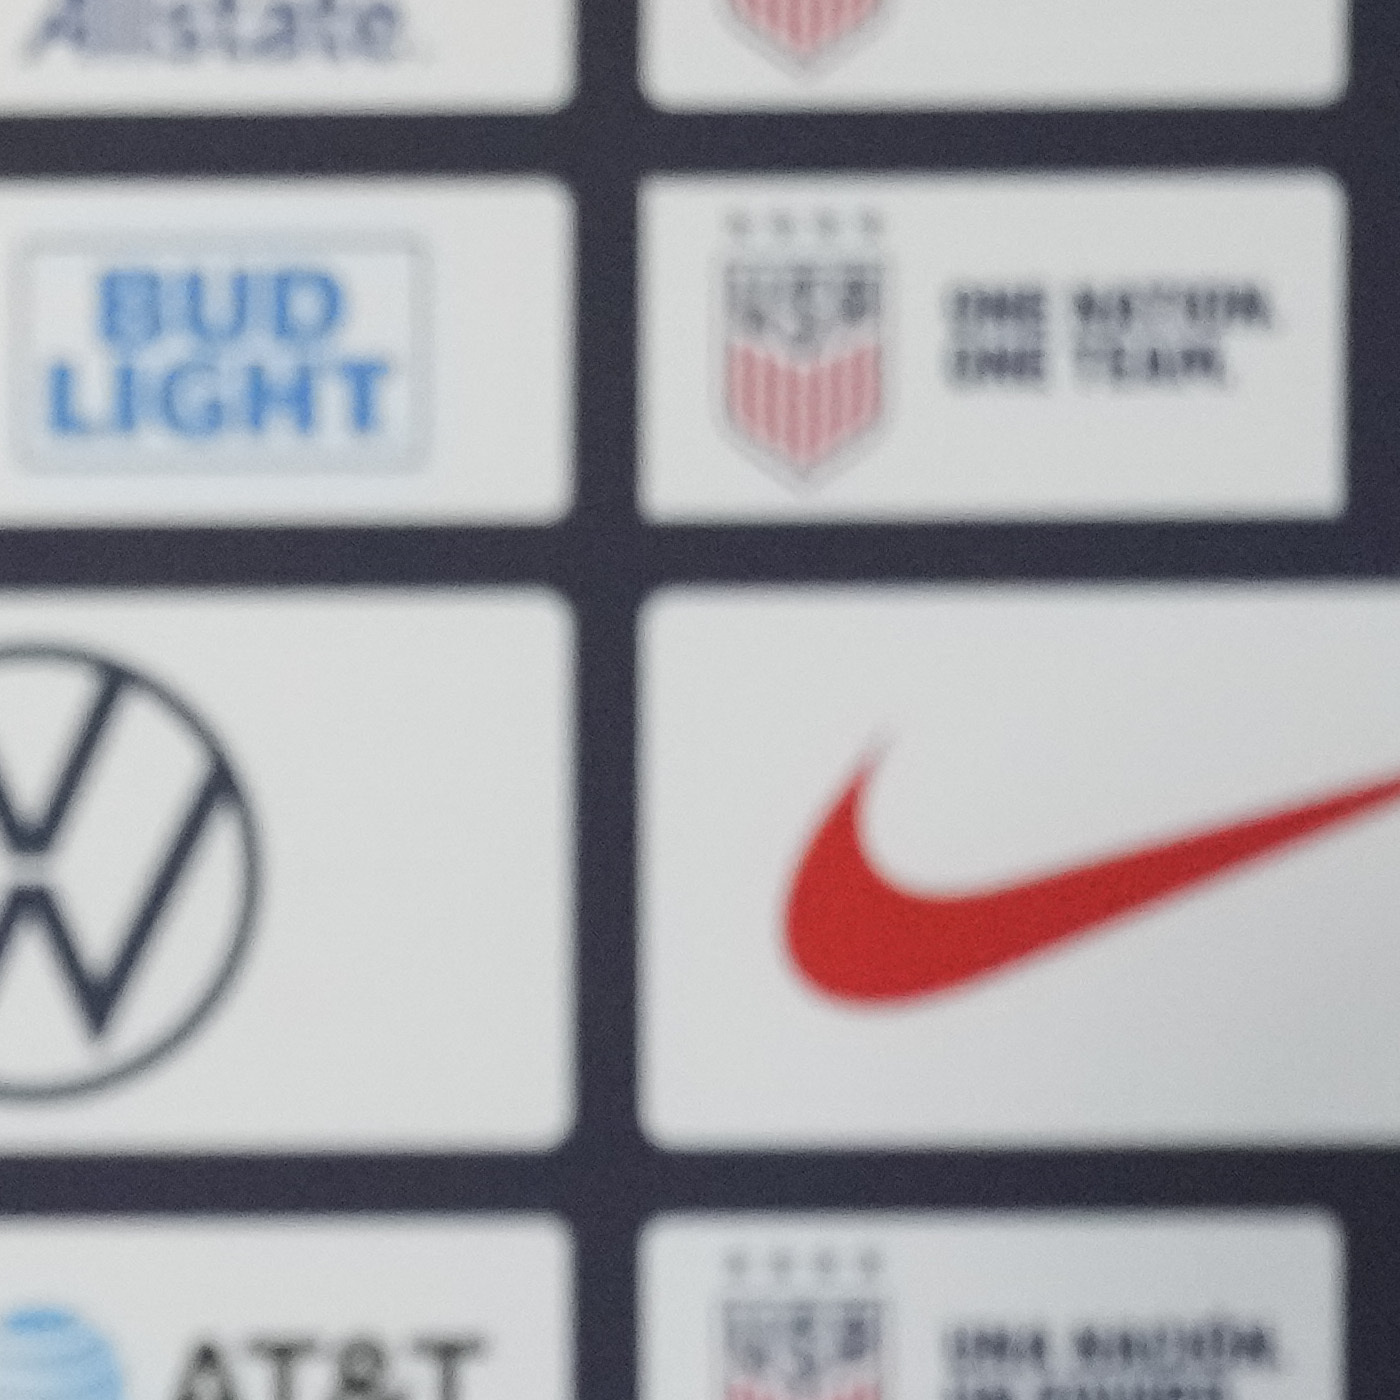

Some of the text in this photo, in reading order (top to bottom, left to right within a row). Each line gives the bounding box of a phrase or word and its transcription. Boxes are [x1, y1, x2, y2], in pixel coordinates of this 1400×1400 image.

[93, 262, 350, 348] BUD
[944, 280, 1050, 330] ONE
[944, 338, 1050, 388] ONE
[45, 355, 392, 441] LIGHT
